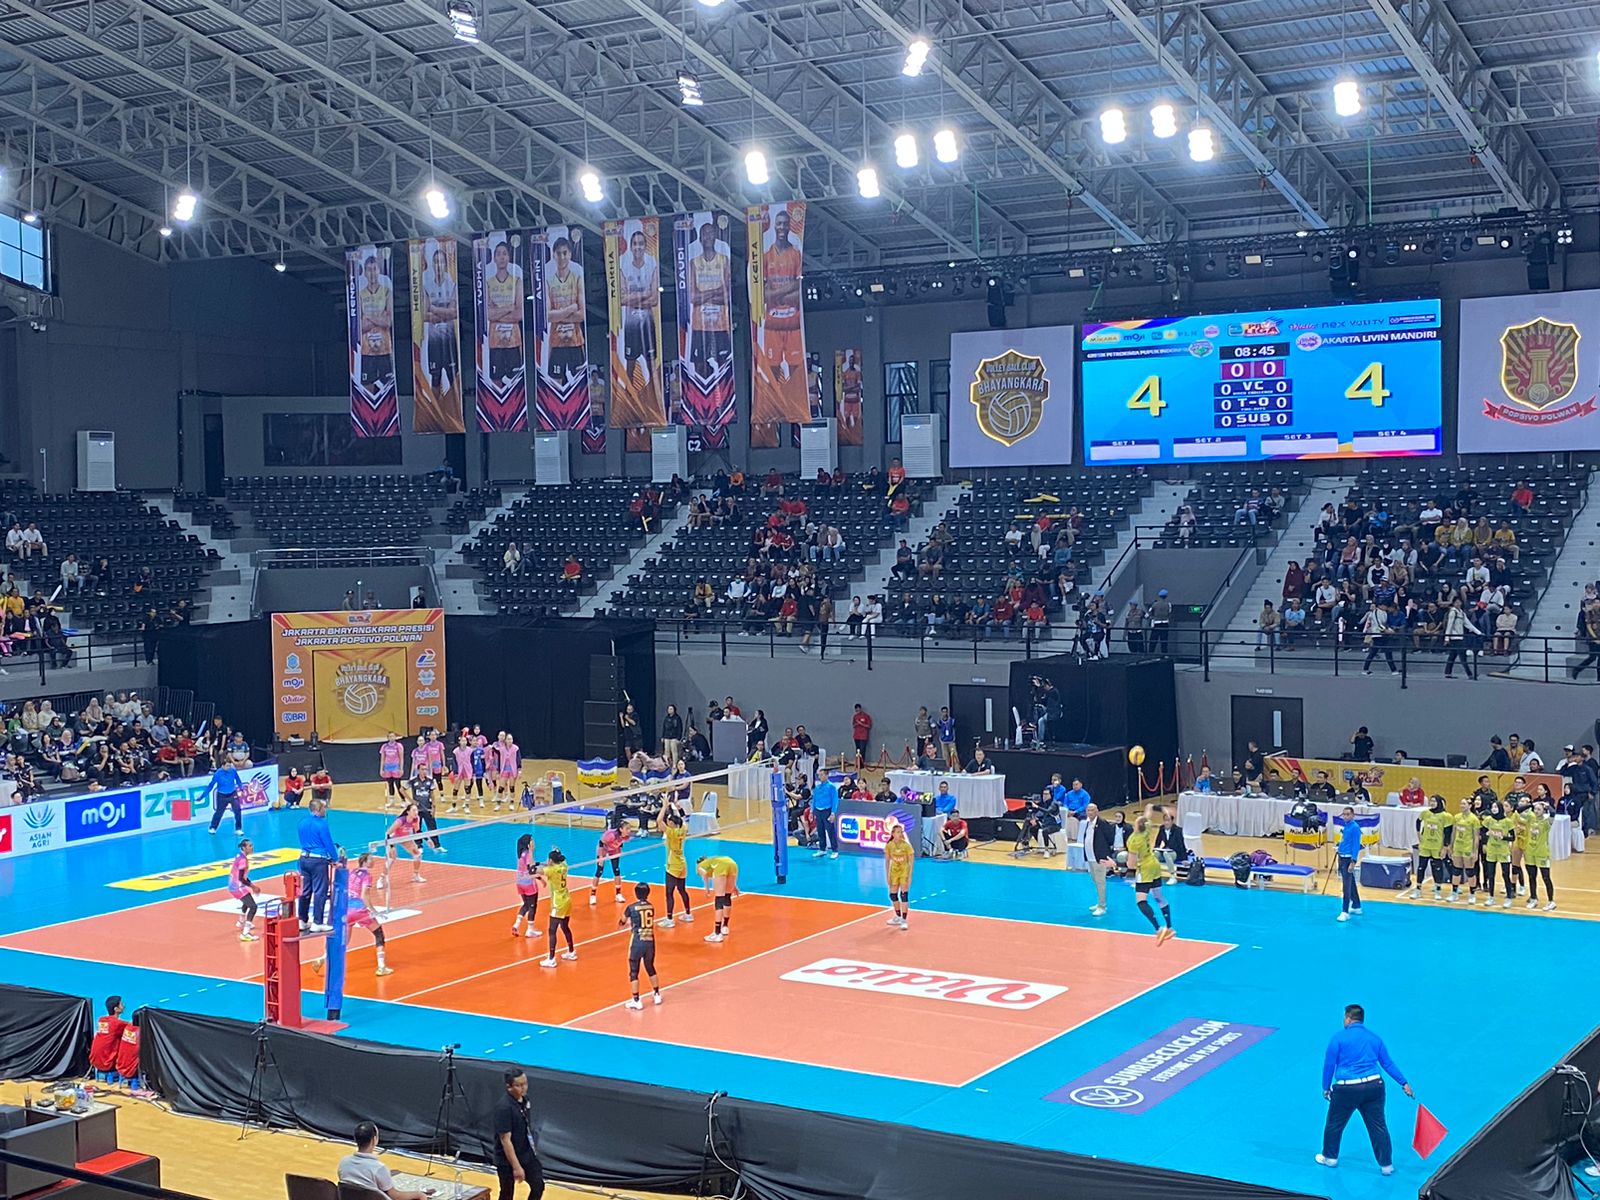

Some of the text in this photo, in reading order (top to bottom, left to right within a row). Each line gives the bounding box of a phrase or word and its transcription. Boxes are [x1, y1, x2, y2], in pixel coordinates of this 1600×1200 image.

[678, 247, 686, 289] DAUDI
[1321, 334, 1361, 345] AKARTA
[1362, 334, 1389, 343] LIVIN
[1390, 331, 1437, 341] MANDIRI
[1235, 346, 1275, 357] 08:45
[1231, 361, 1276, 377] 0 0
[977, 376, 1044, 395] BHAYANGKARA
[1221, 381, 1287, 395] 0 VC 0
[1345, 362, 1391, 406] 4
[1127, 375, 1168, 417] 4
[1221, 400, 1231, 411] 0
[1276, 397, 1287, 409] 0
[1222, 415, 1232, 427] 0
[1236, 413, 1271, 423] SUB
[1276, 413, 1287, 425] 0
[1503, 406, 1577, 421] POPSIVO POLWAN
[687, 440, 701, 451] C2
[282, 623, 434, 637] JAKARTA BHAYANGKARA PRESISI
[295, 633, 422, 646] JAKARTA POPSIVO POLWAN
[335, 674, 387, 687] BHAYANGKARA
[292, 712, 306, 721] BRI
[29, 832, 52, 842] ASIAN
[860, 829, 892, 843] LIG
[32, 840, 50, 849] AGRI
[561, 873, 567, 888] 5
[639, 909, 653, 928] 16
[800, 965, 1042, 1004] Vidio
[1103, 1019, 1230, 1087] SUNRISECLICK.COM
